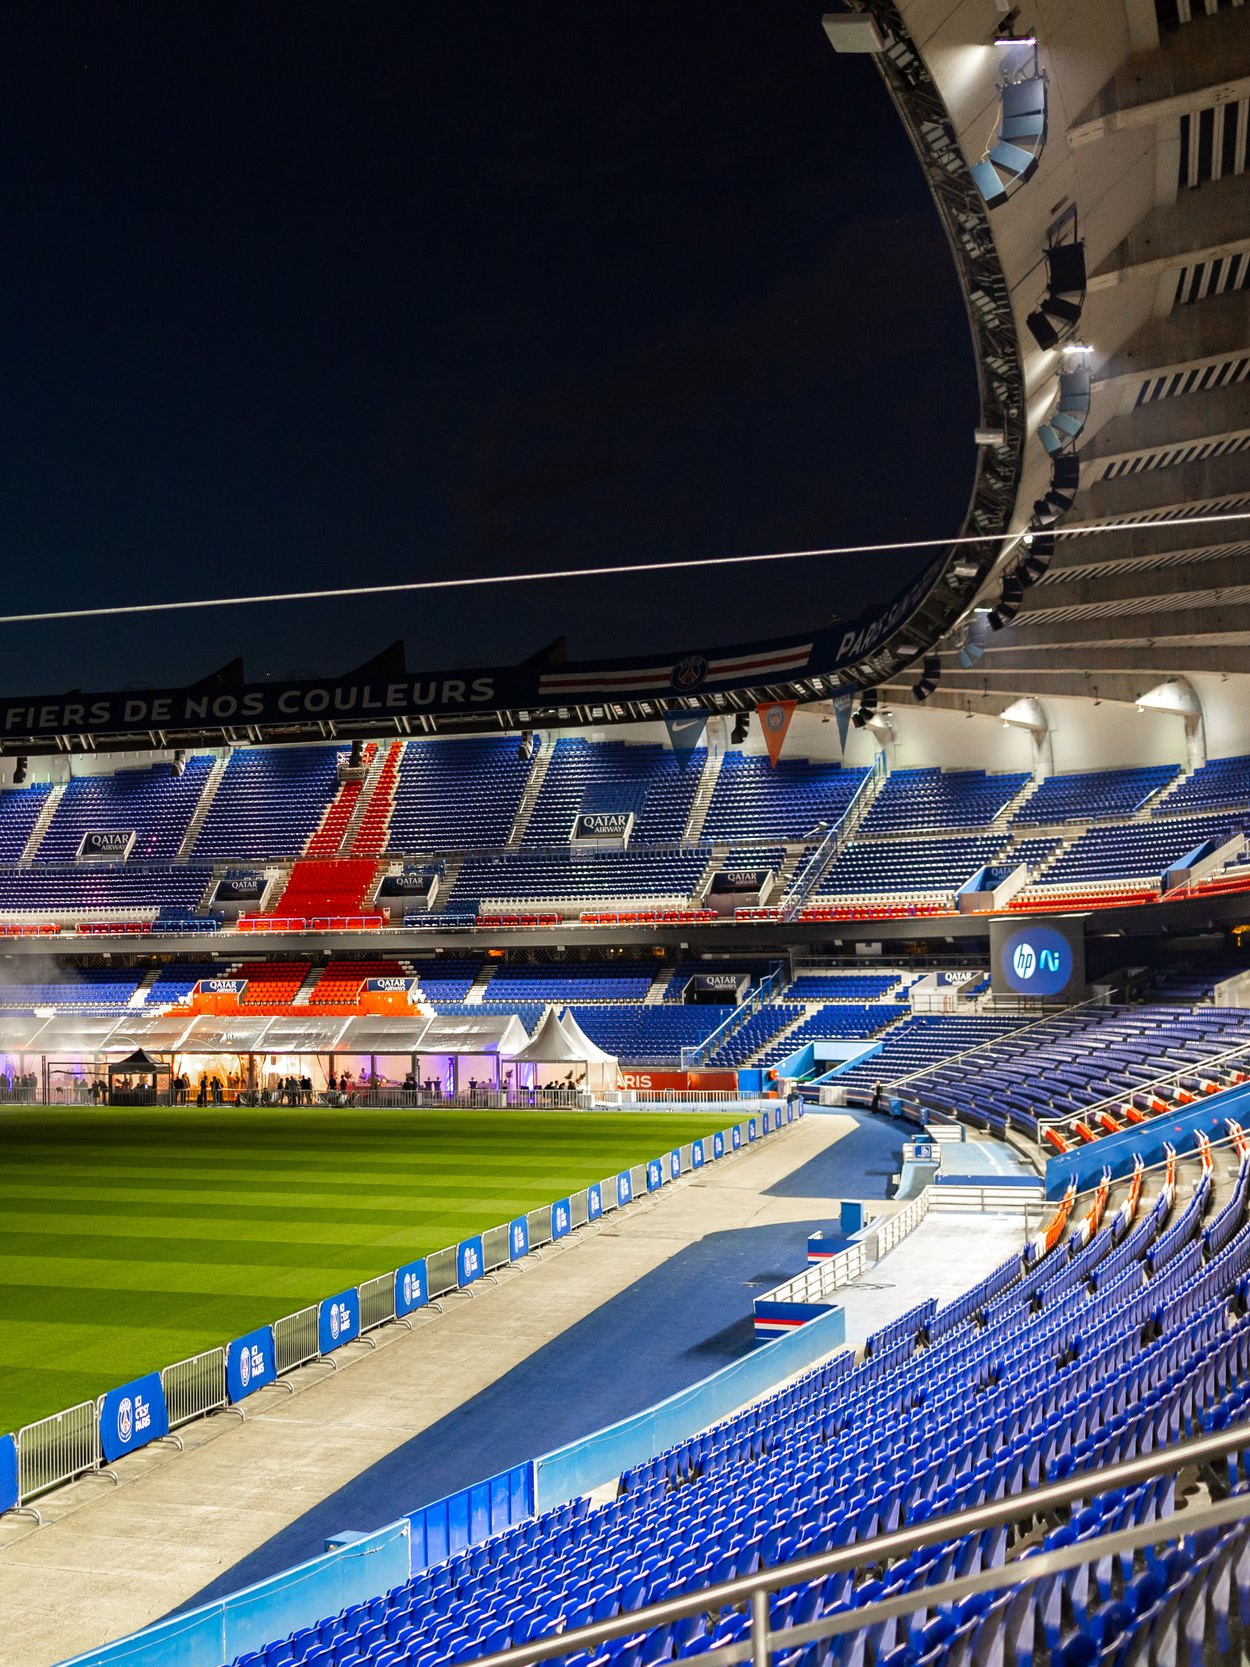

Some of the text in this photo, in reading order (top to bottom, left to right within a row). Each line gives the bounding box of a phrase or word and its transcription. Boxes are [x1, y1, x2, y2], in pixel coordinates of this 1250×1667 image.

[4, 677, 495, 731] FIERS DE NOS COULEURS
[584, 815, 626, 829] QATAR
[92, 834, 129, 847] QATAR
[396, 877, 423, 886] QATAR
[728, 872, 757, 882] QATAR
[231, 881, 258, 889] QATAR
[706, 976, 736, 986] QATAR
[944, 972, 972, 983] QATAR
[209, 981, 237, 990] QATAR
[377, 979, 406, 988] QATAR
[135, 1414, 151, 1432] PARIS
